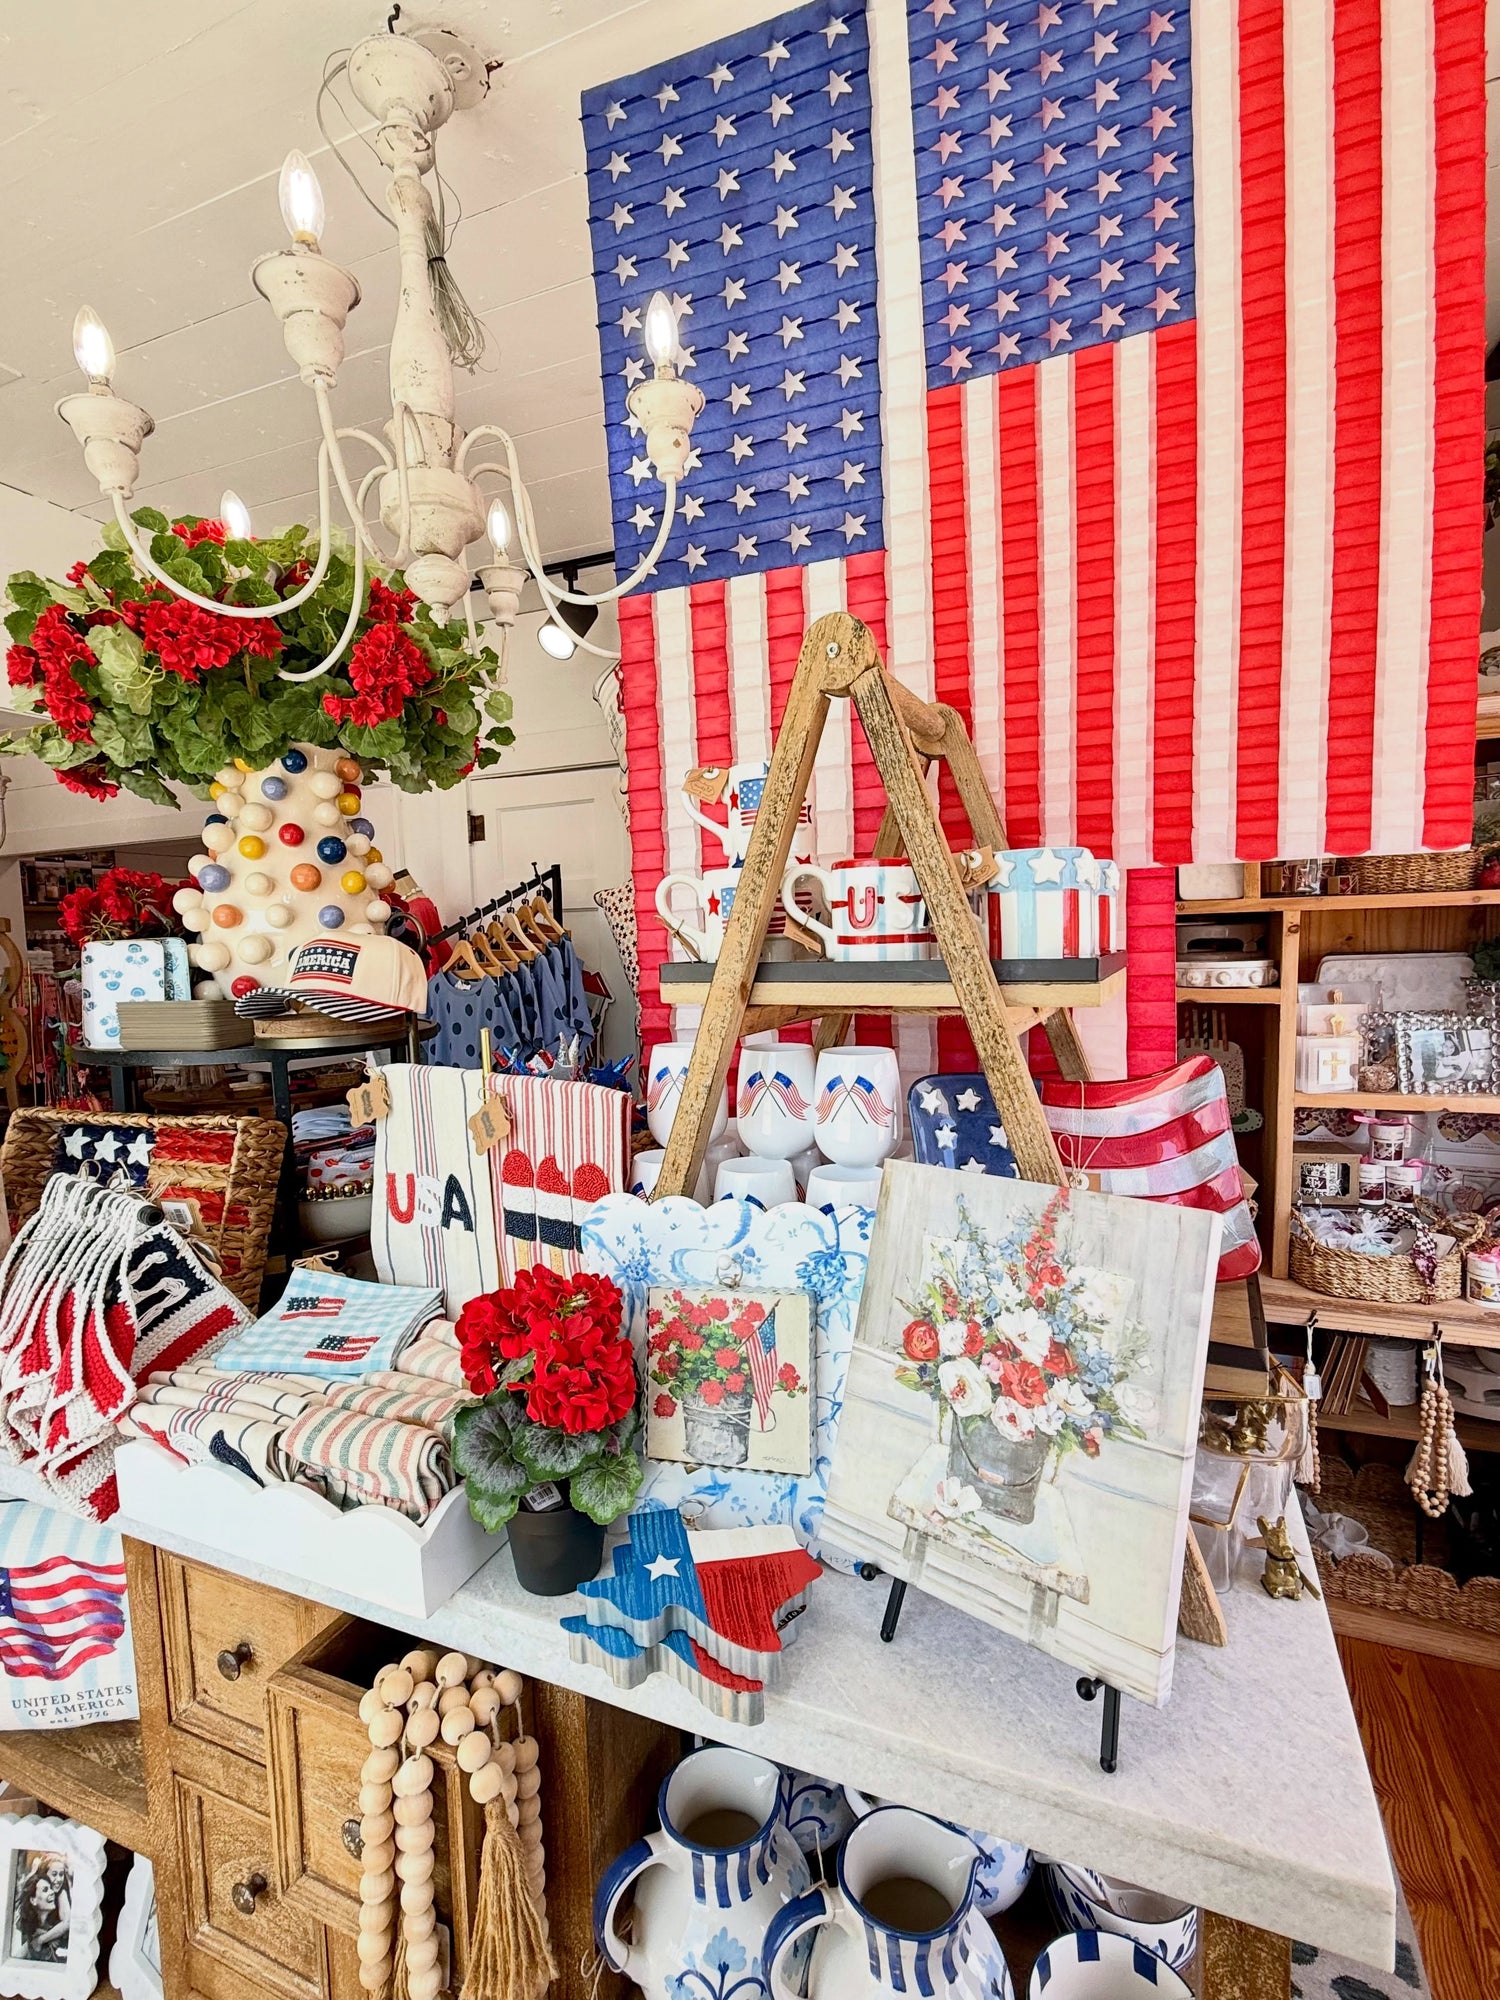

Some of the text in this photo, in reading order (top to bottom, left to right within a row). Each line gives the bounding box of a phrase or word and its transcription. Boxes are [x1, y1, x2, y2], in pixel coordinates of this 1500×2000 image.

[847, 886, 932, 930] US
[386, 1172, 474, 1232] USA
[12, 1684, 133, 1709] UNITED STATES
[28, 1697, 125, 1718] OF AMERICA
[80, 1710, 109, 1720] 1776
